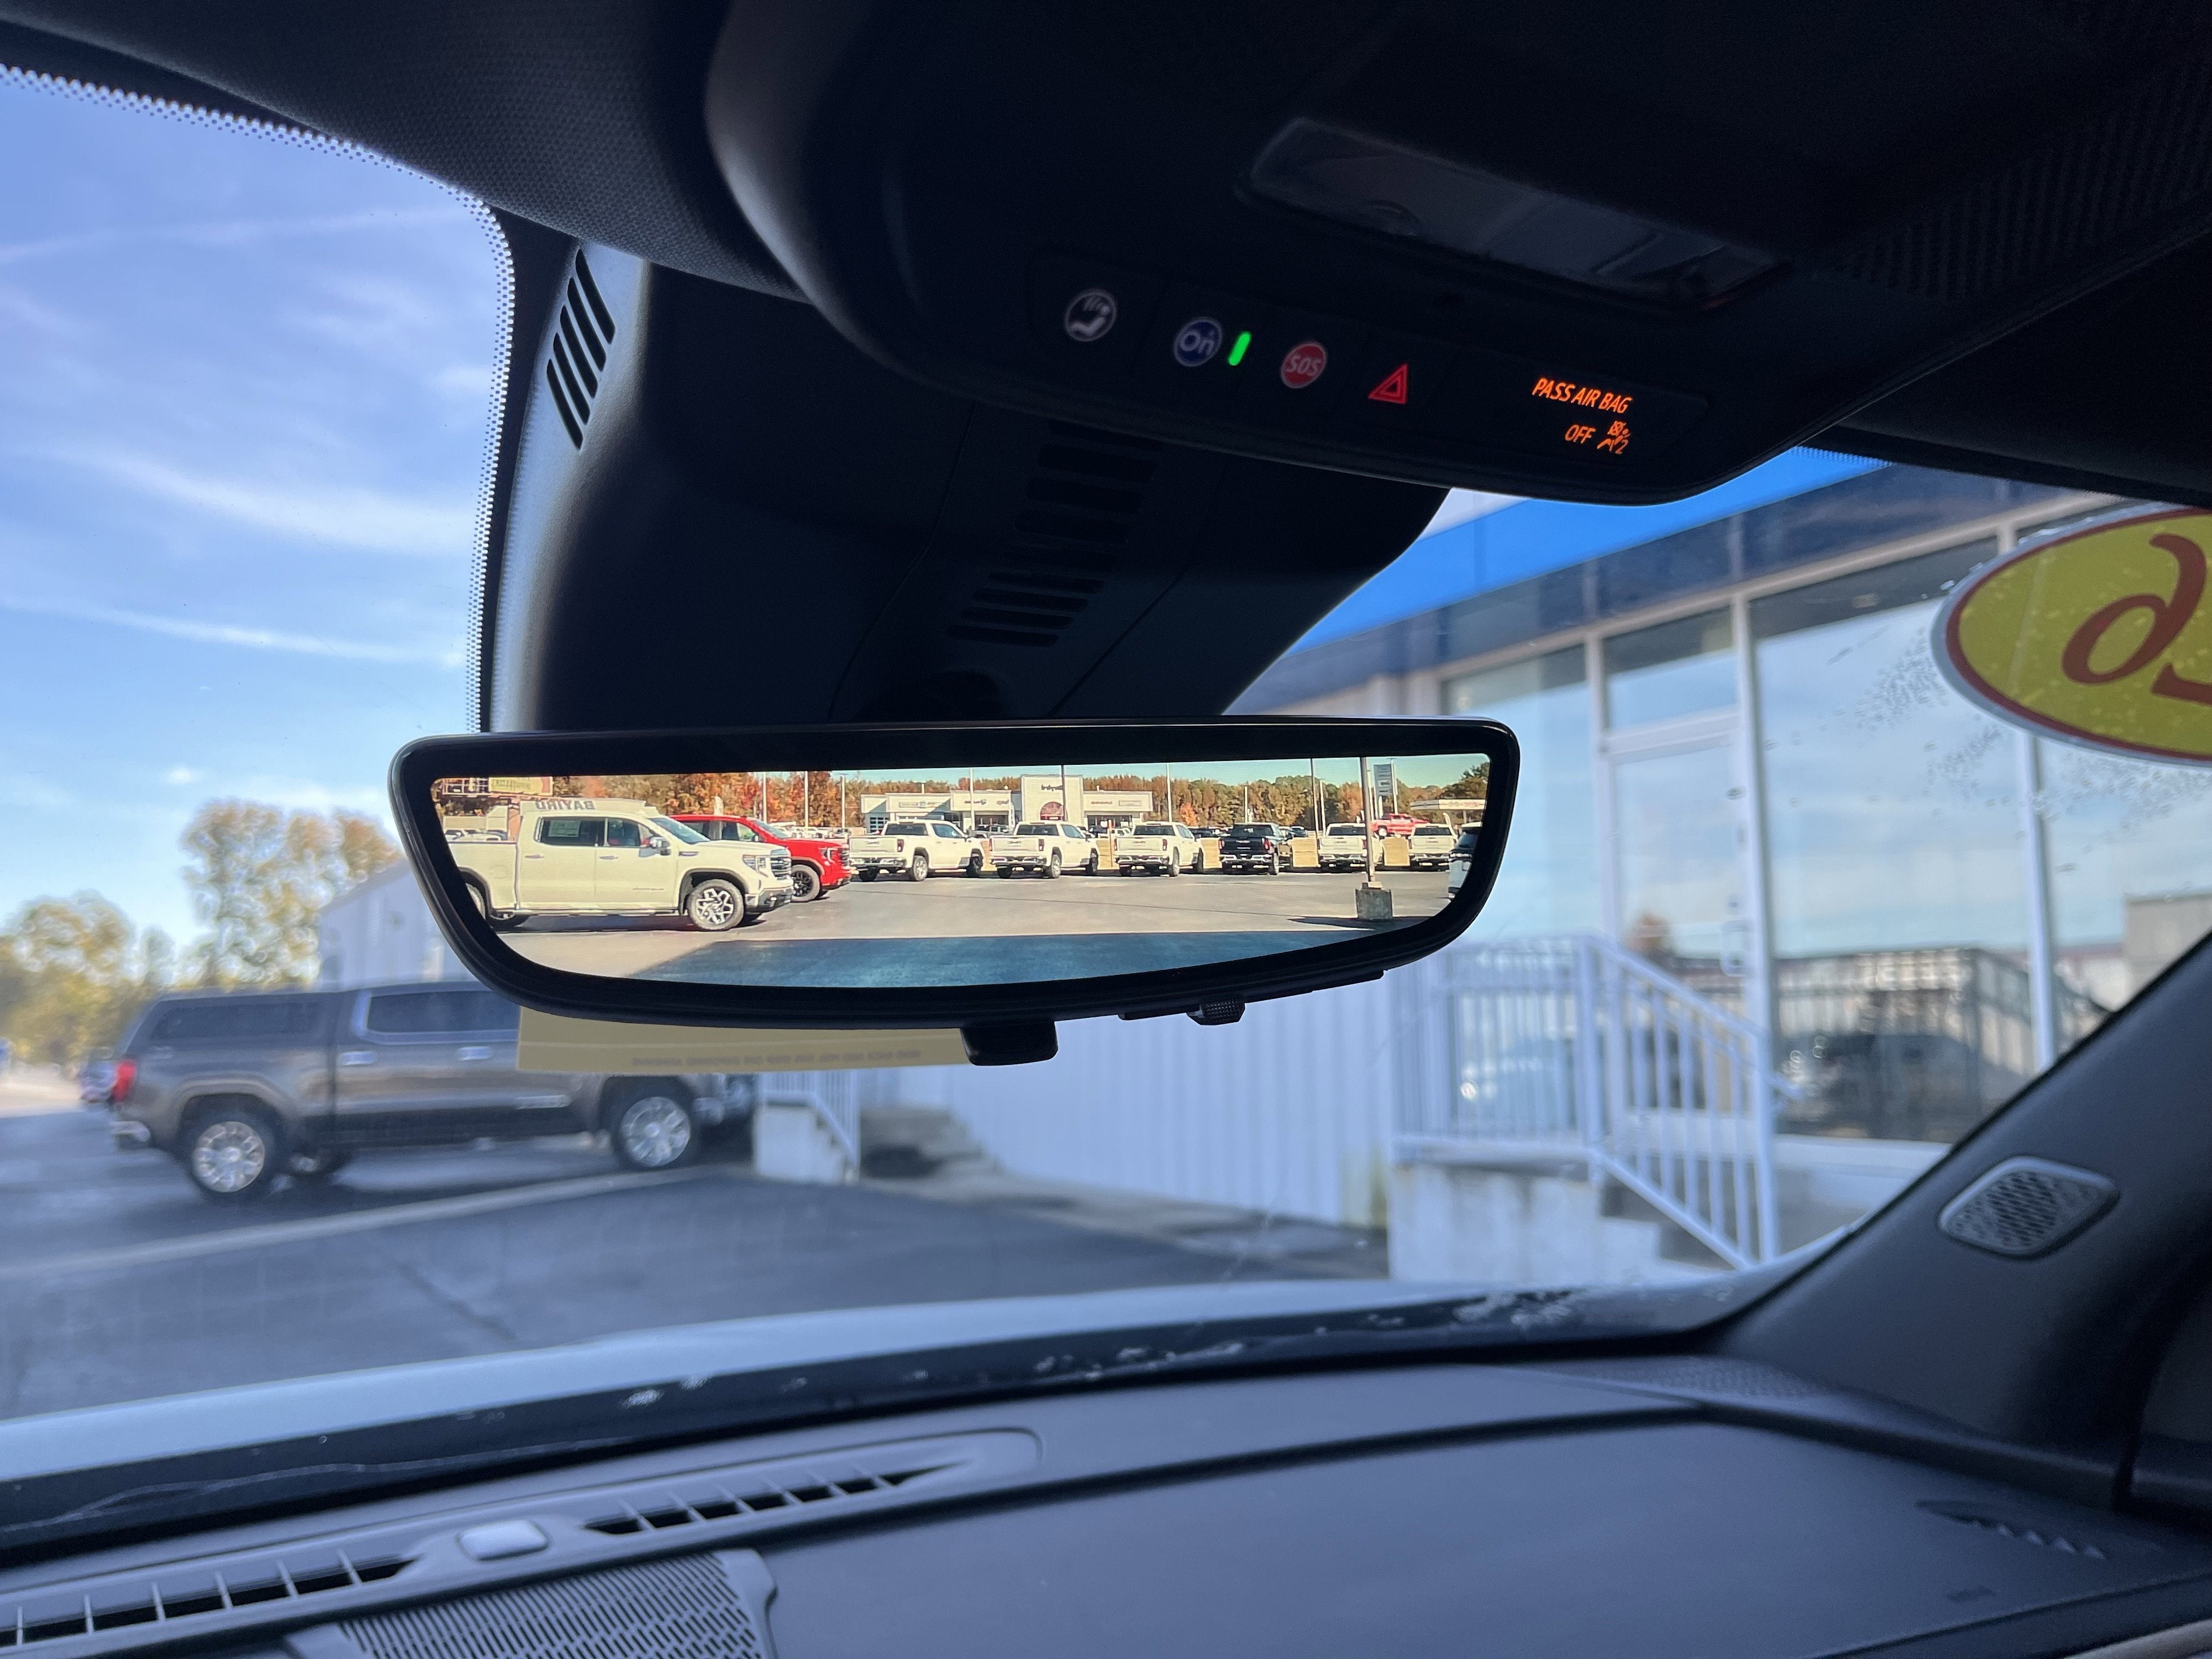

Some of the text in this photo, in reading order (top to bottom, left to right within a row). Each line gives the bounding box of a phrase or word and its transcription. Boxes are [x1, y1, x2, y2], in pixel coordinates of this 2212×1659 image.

[1179, 330, 1215, 356] On
[1285, 354, 1322, 376] SOS
[1531, 377, 1633, 414] PASS AIR BAG
[1564, 424, 1597, 444] OFF
